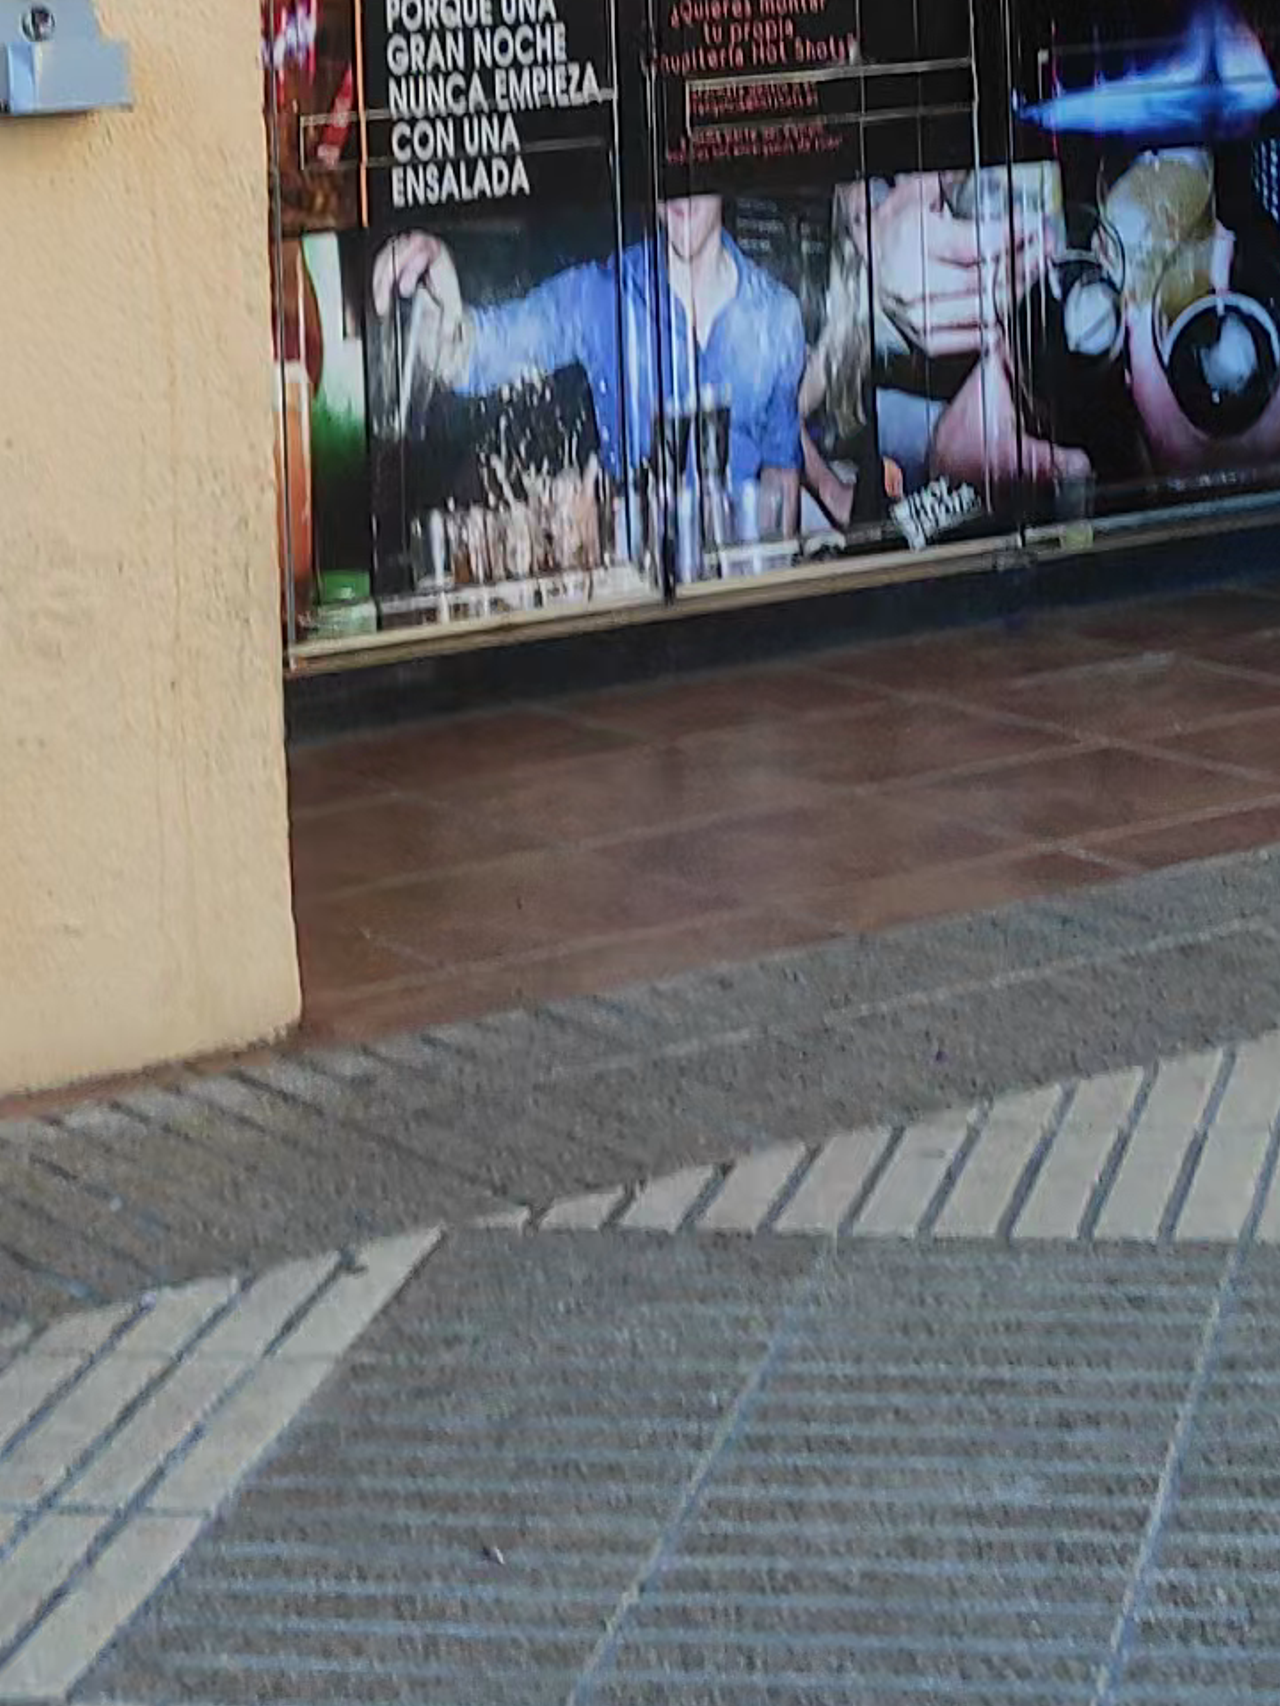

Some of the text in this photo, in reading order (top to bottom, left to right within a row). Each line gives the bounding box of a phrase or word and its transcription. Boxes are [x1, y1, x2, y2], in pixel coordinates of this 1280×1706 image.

[386, 21, 568, 76] GRAN NOCHE
[388, 61, 601, 120] NUNCA EMPIEZA
[391, 112, 522, 164] CON UNA
[391, 156, 531, 209] ENSALADA
